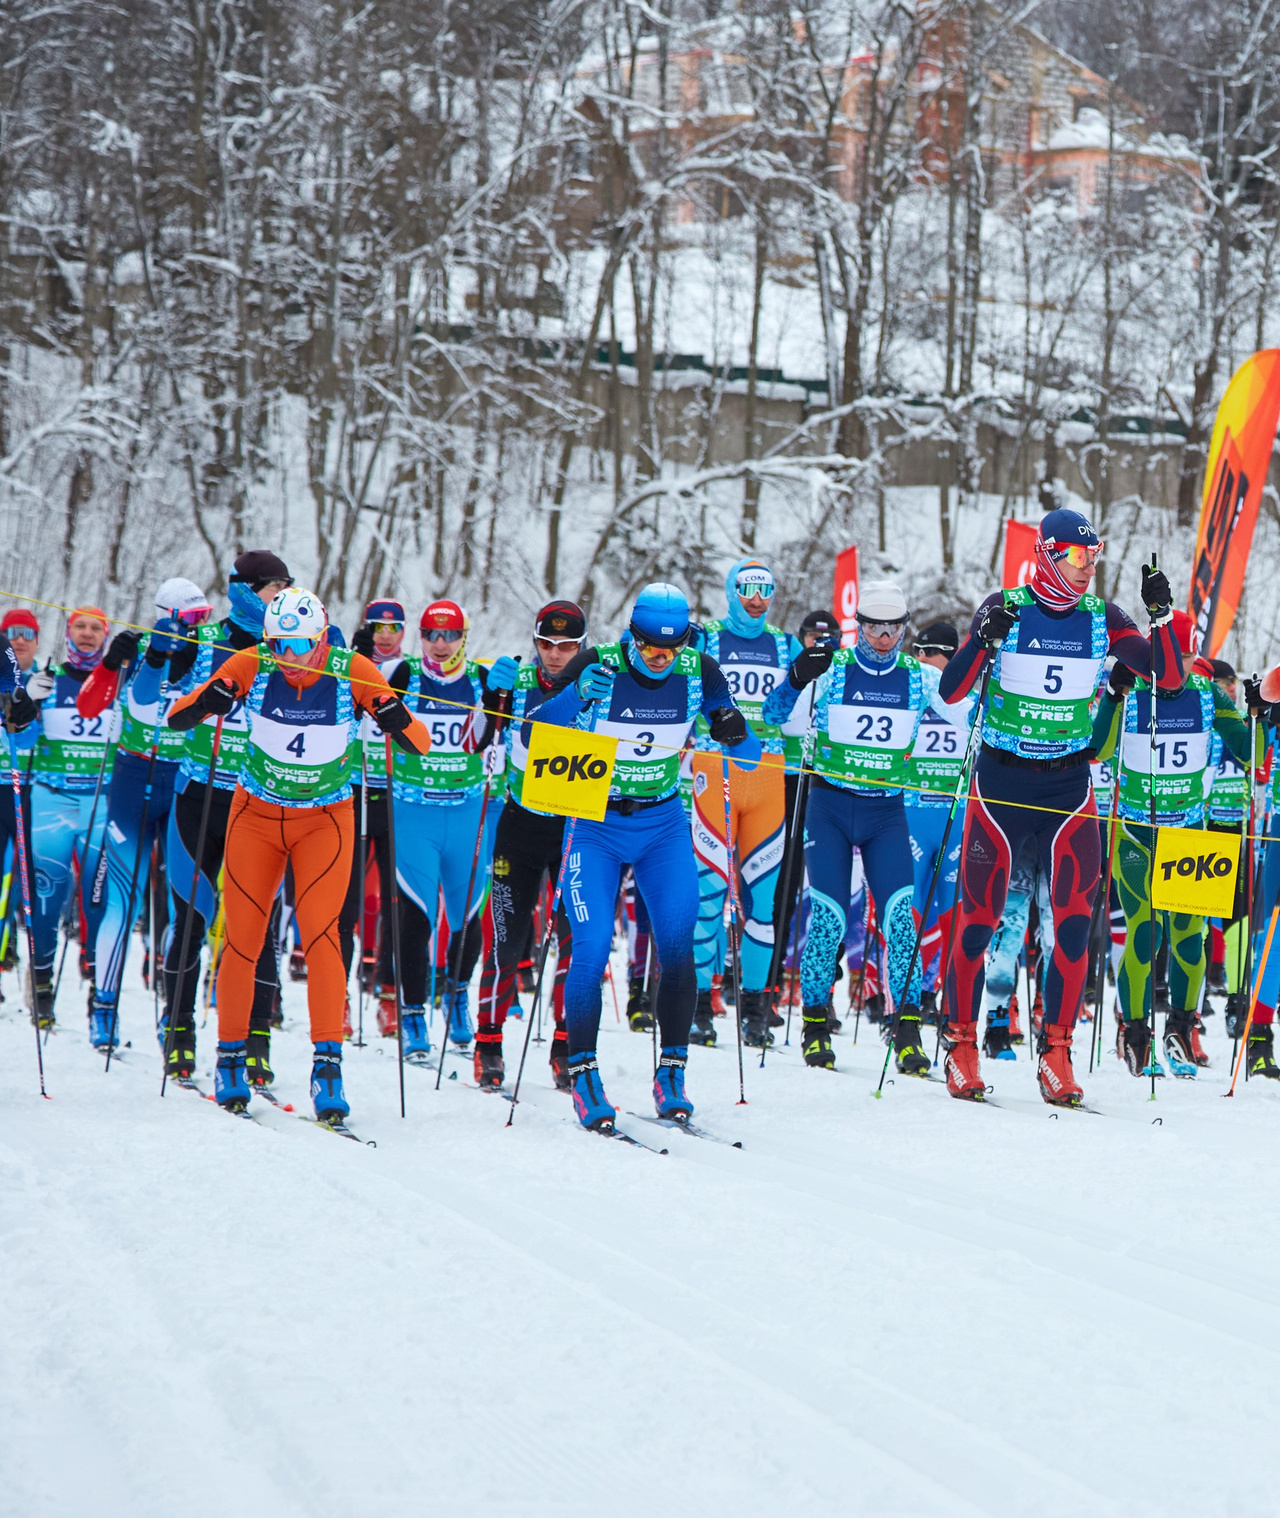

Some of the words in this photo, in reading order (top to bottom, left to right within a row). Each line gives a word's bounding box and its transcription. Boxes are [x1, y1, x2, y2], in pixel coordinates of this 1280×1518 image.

[1008, 590, 1025, 600] 51
[1084, 597, 1100, 607] 51
[202, 626, 219, 637] 51
[1041, 643, 1083, 652] TOKSOVOCUP
[332, 657, 348, 670] 51
[681, 654, 697, 667] 51
[726, 671, 775, 697] 308
[1043, 664, 1064, 694] 5
[1018, 708, 1074, 722] TYRES
[70, 715, 103, 737] 32
[432, 722, 463, 746] 50
[856, 714, 893, 742] 23
[286, 733, 306, 758] 4
[633, 732, 655, 757] 3
[926, 731, 957, 753] 25
[844, 756, 892, 770] TYRES
[1155, 741, 1188, 768] 15
[265, 768, 320, 784] TYRES
[421, 763, 467, 771] TYRES
[533, 753, 607, 782] TOKO
[917, 768, 960, 777] TYRES
[612, 771, 665, 782] TYRES
[698, 831, 719, 851] COM
[1161, 852, 1232, 882] TOKO
[569, 852, 589, 923] SPINE
[502, 883, 515, 915] SAINT
[1158, 899, 1227, 914] www.tokowax.com
[493, 879, 507, 944] PETERSBURG
[569, 1060, 598, 1076] SPINE
[661, 1058, 687, 1068] SPIN
